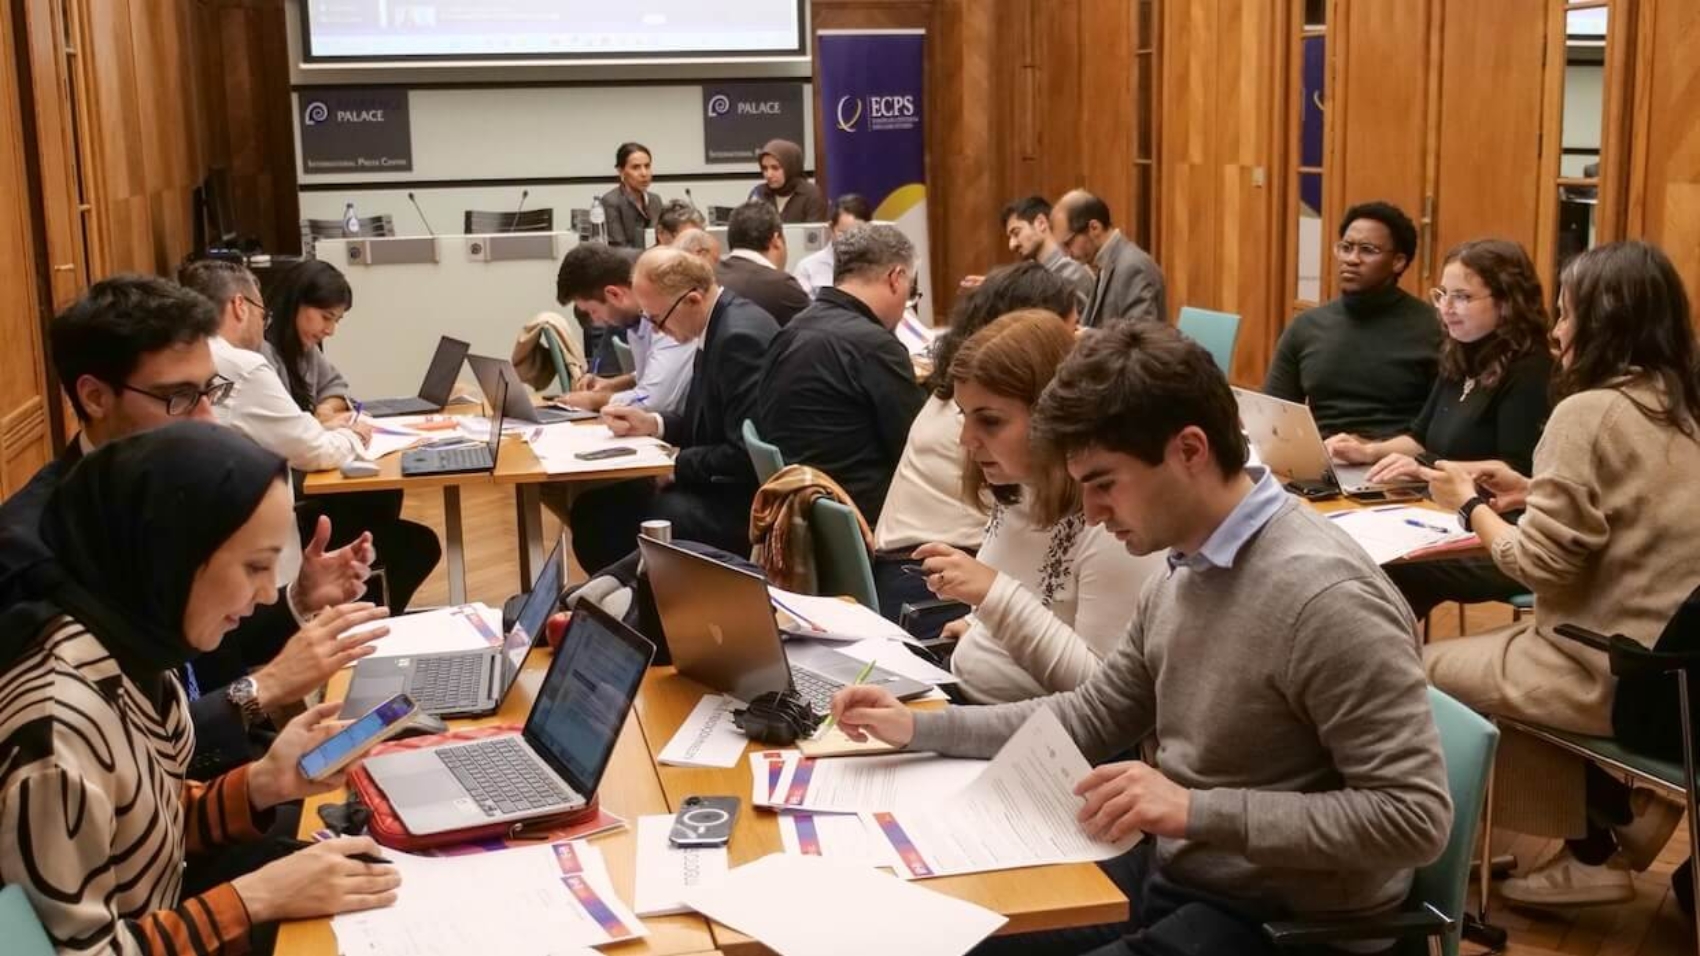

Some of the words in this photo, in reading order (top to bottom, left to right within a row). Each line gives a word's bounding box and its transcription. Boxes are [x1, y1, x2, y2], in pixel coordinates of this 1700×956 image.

[737, 101, 781, 114] PALACE
[871, 95, 914, 117] ECPS
[338, 110, 385, 122] PALACE
